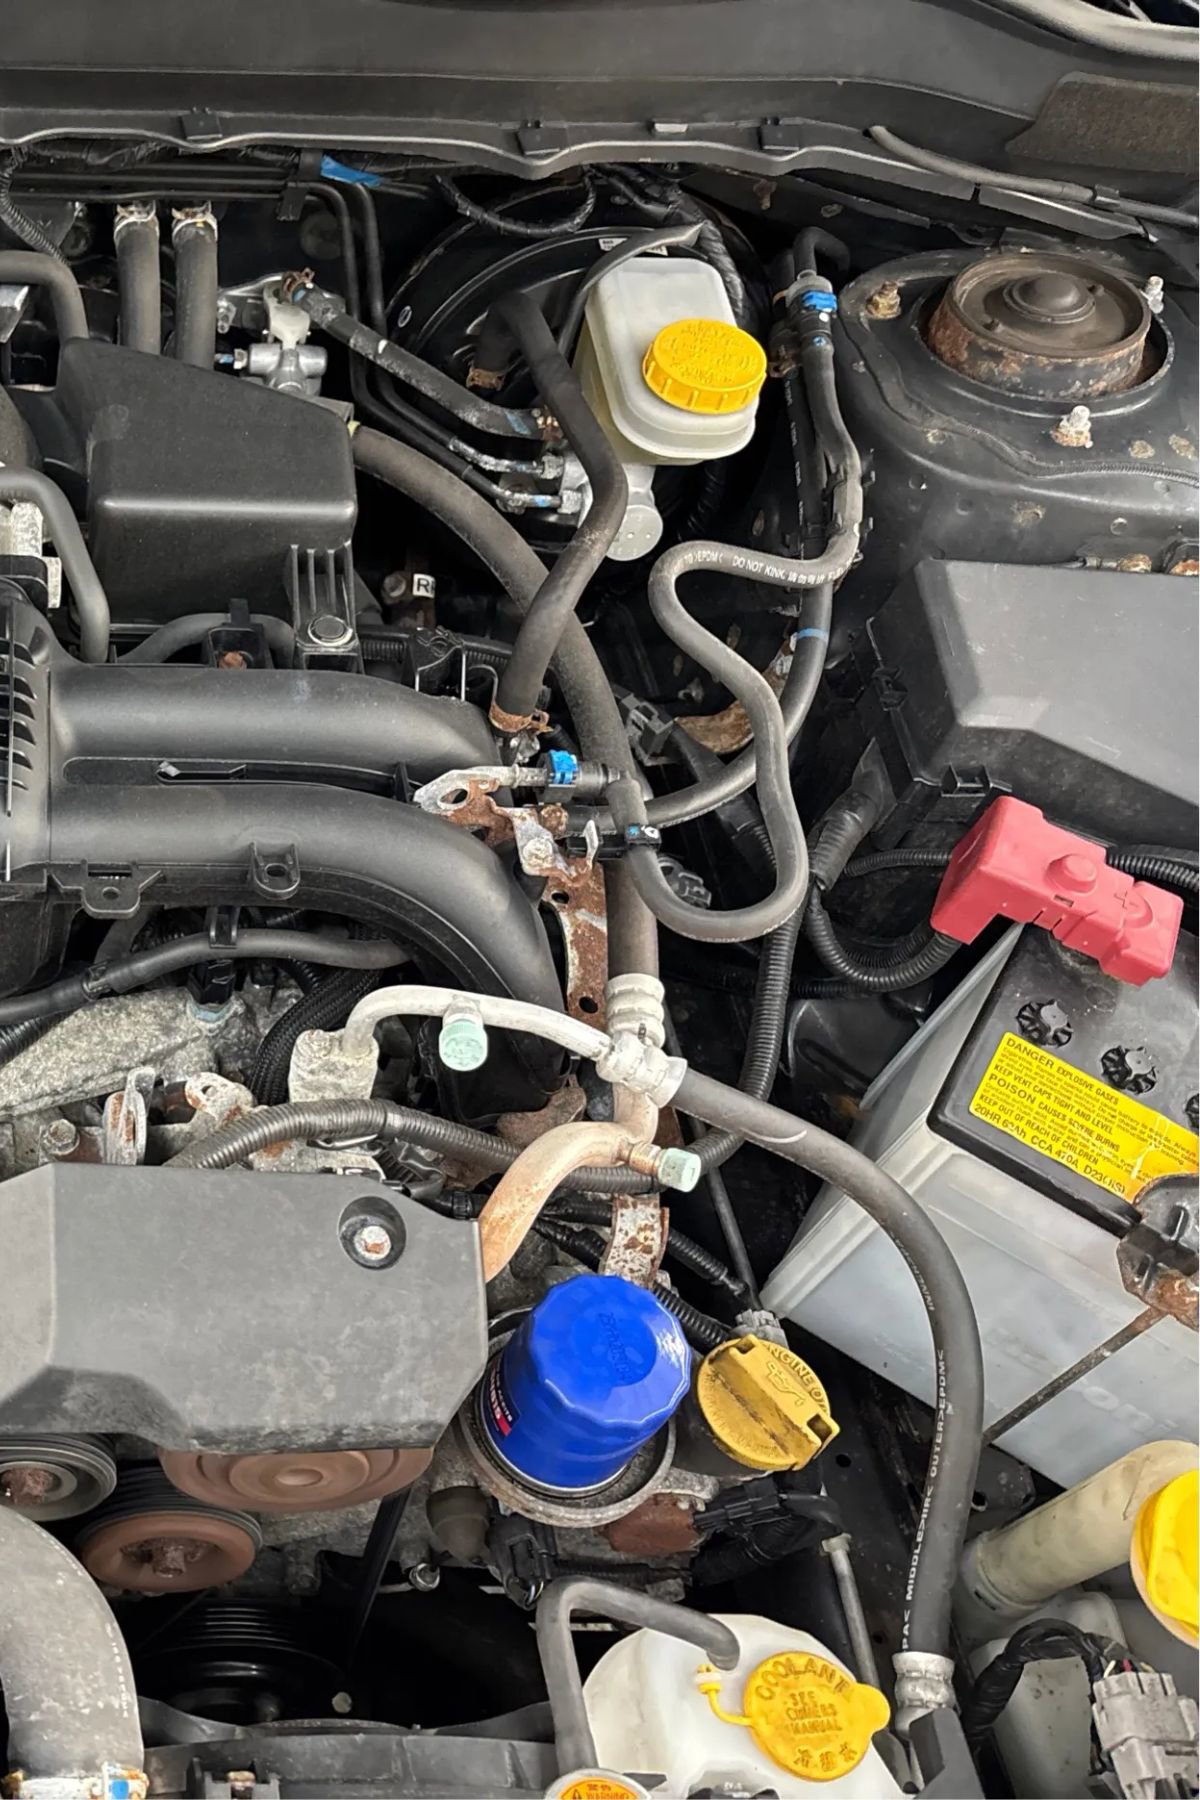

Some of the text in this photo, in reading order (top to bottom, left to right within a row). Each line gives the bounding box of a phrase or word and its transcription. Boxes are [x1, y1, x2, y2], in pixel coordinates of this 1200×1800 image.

[732, 555, 745, 569] DO
[746, 560, 764, 573] NOT
[993, 1063, 1114, 1134] KEEP VENT CAPS TIGHT AND LEVEL
[1005, 1037, 1119, 1105] DANGER EXPLOSIVE GASES
[973, 1103, 1001, 1123] 20HR
[1029, 1135, 1056, 1154] CCA
[978, 1094, 997, 1108] KEEP
[997, 1104, 1013, 1117] OUT
[1013, 1113, 1024, 1123] OF
[1024, 1119, 1050, 1137] REACH
[1050, 1133, 1061, 1143] OF
[1060, 1139, 1099, 1164] CHILDREN
[987, 1073, 1036, 1104] POISON
[1037, 1101, 1067, 1121] CAUSES
[1094, 1133, 1121, 1152] BURNS
[755, 1657, 850, 1701] COOLANT
[789, 1691, 816, 1707] SEE
